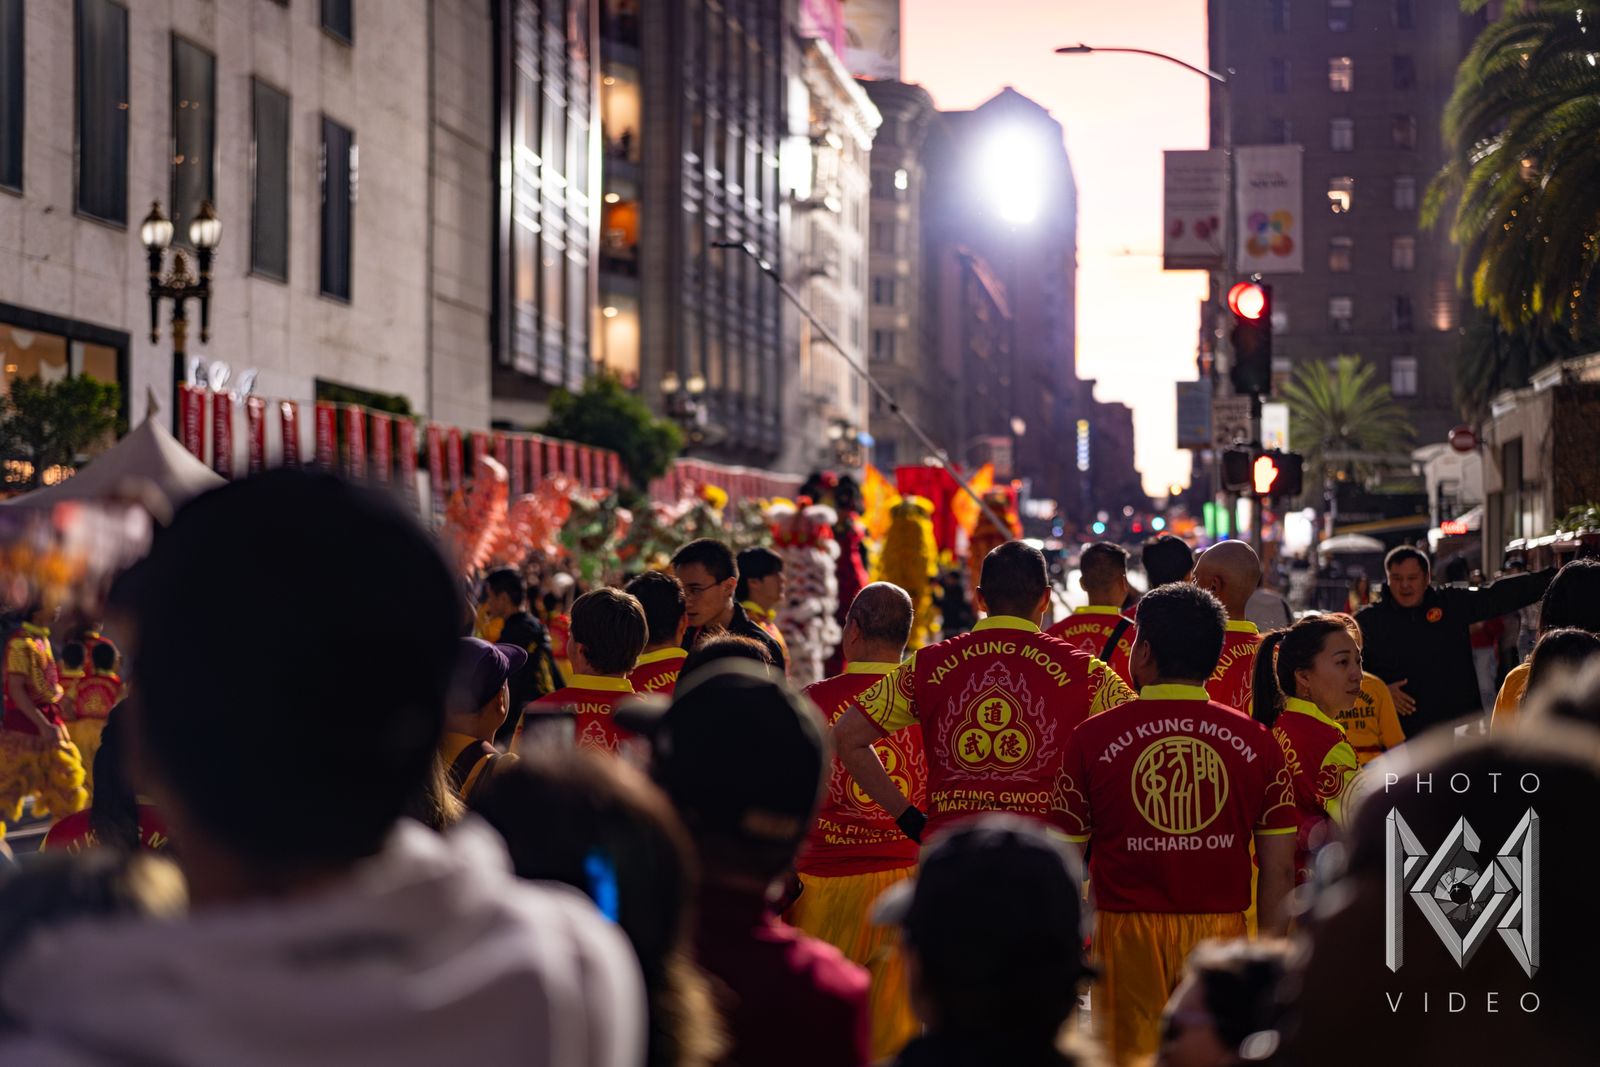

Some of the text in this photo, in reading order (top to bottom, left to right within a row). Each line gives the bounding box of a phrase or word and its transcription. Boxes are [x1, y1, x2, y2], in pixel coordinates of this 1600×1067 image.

[1064, 623, 1101, 638] KUNG
[927, 641, 1071, 687] YAU KUNG MOON
[1208, 653, 1233, 681] YAU
[983, 701, 1004, 727] 道
[964, 732, 985, 758] 武
[1099, 718, 1257, 764] YAU KUNG MOON
[817, 818, 841, 833] TAK
[1126, 834, 1235, 852] RICHARD OW
